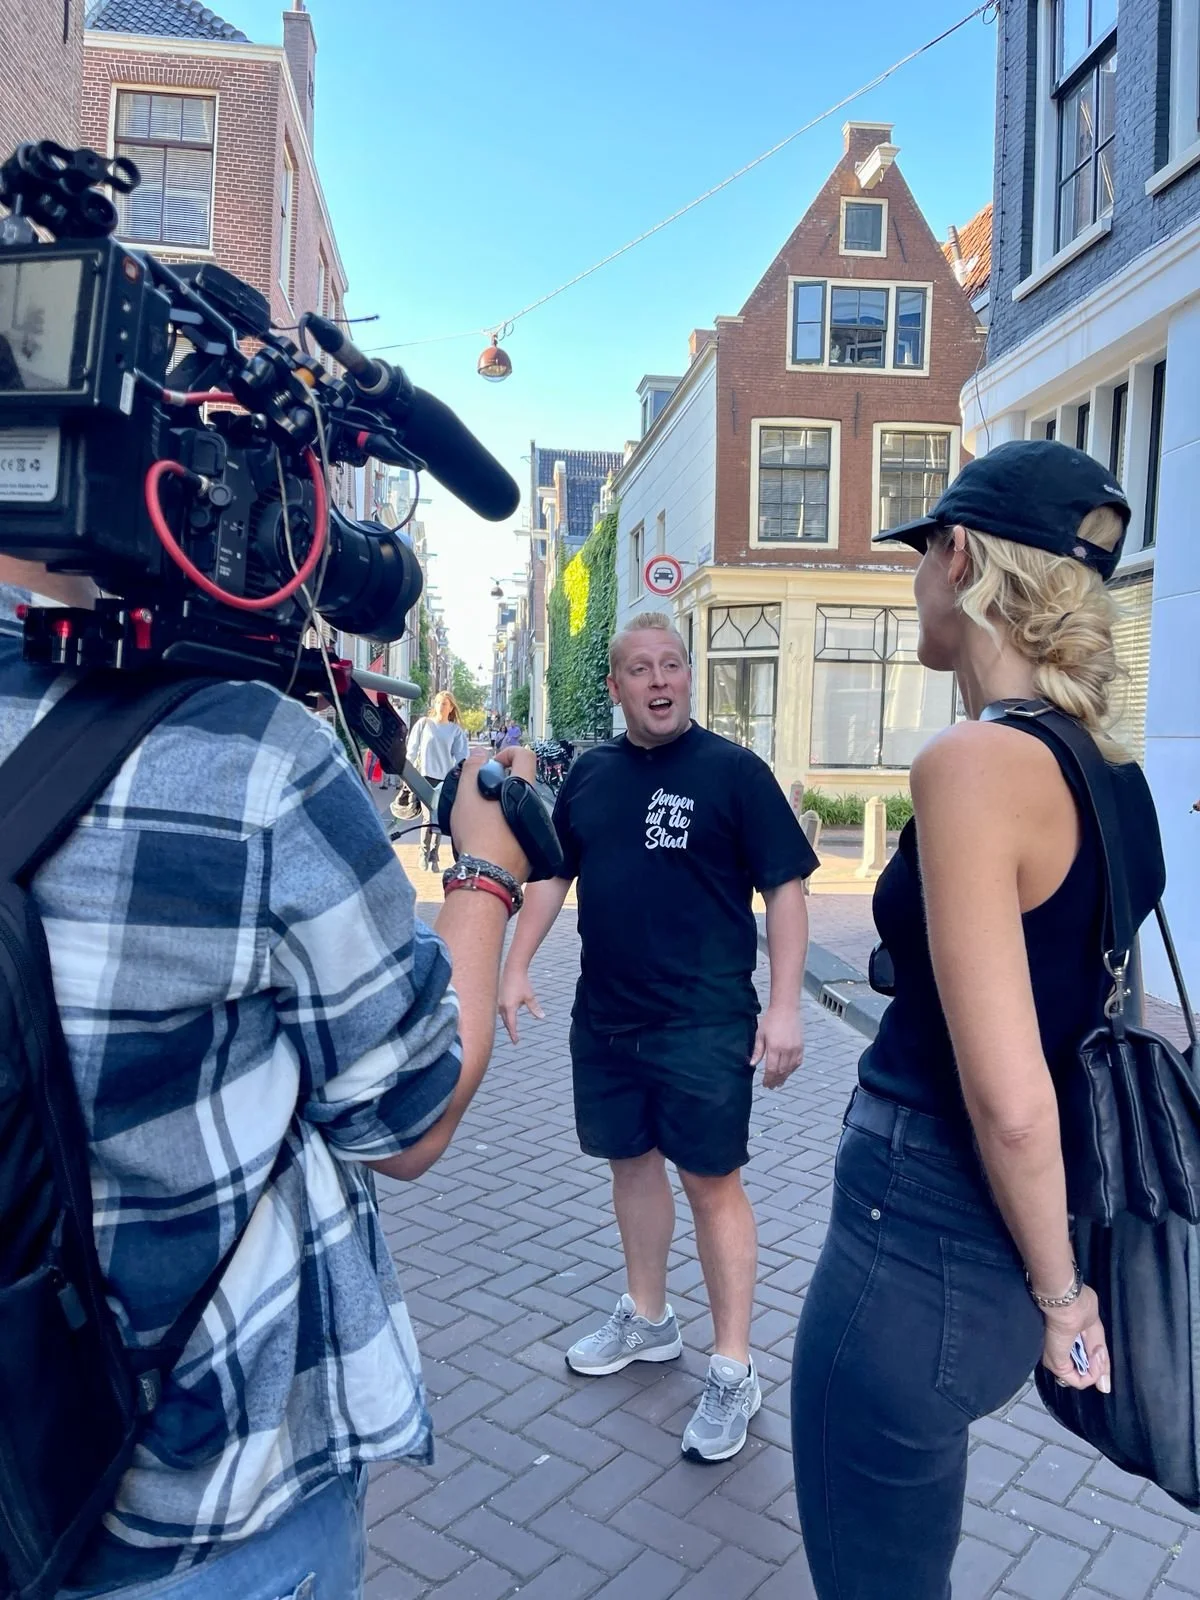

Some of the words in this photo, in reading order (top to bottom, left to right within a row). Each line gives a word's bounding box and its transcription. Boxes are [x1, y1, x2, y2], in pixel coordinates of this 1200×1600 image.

[647, 787, 695, 815] Jongen
[645, 807, 666, 825] uit
[668, 809, 690, 829] de
[645, 825, 689, 850] Stad
[626, 1331, 644, 1349] N
